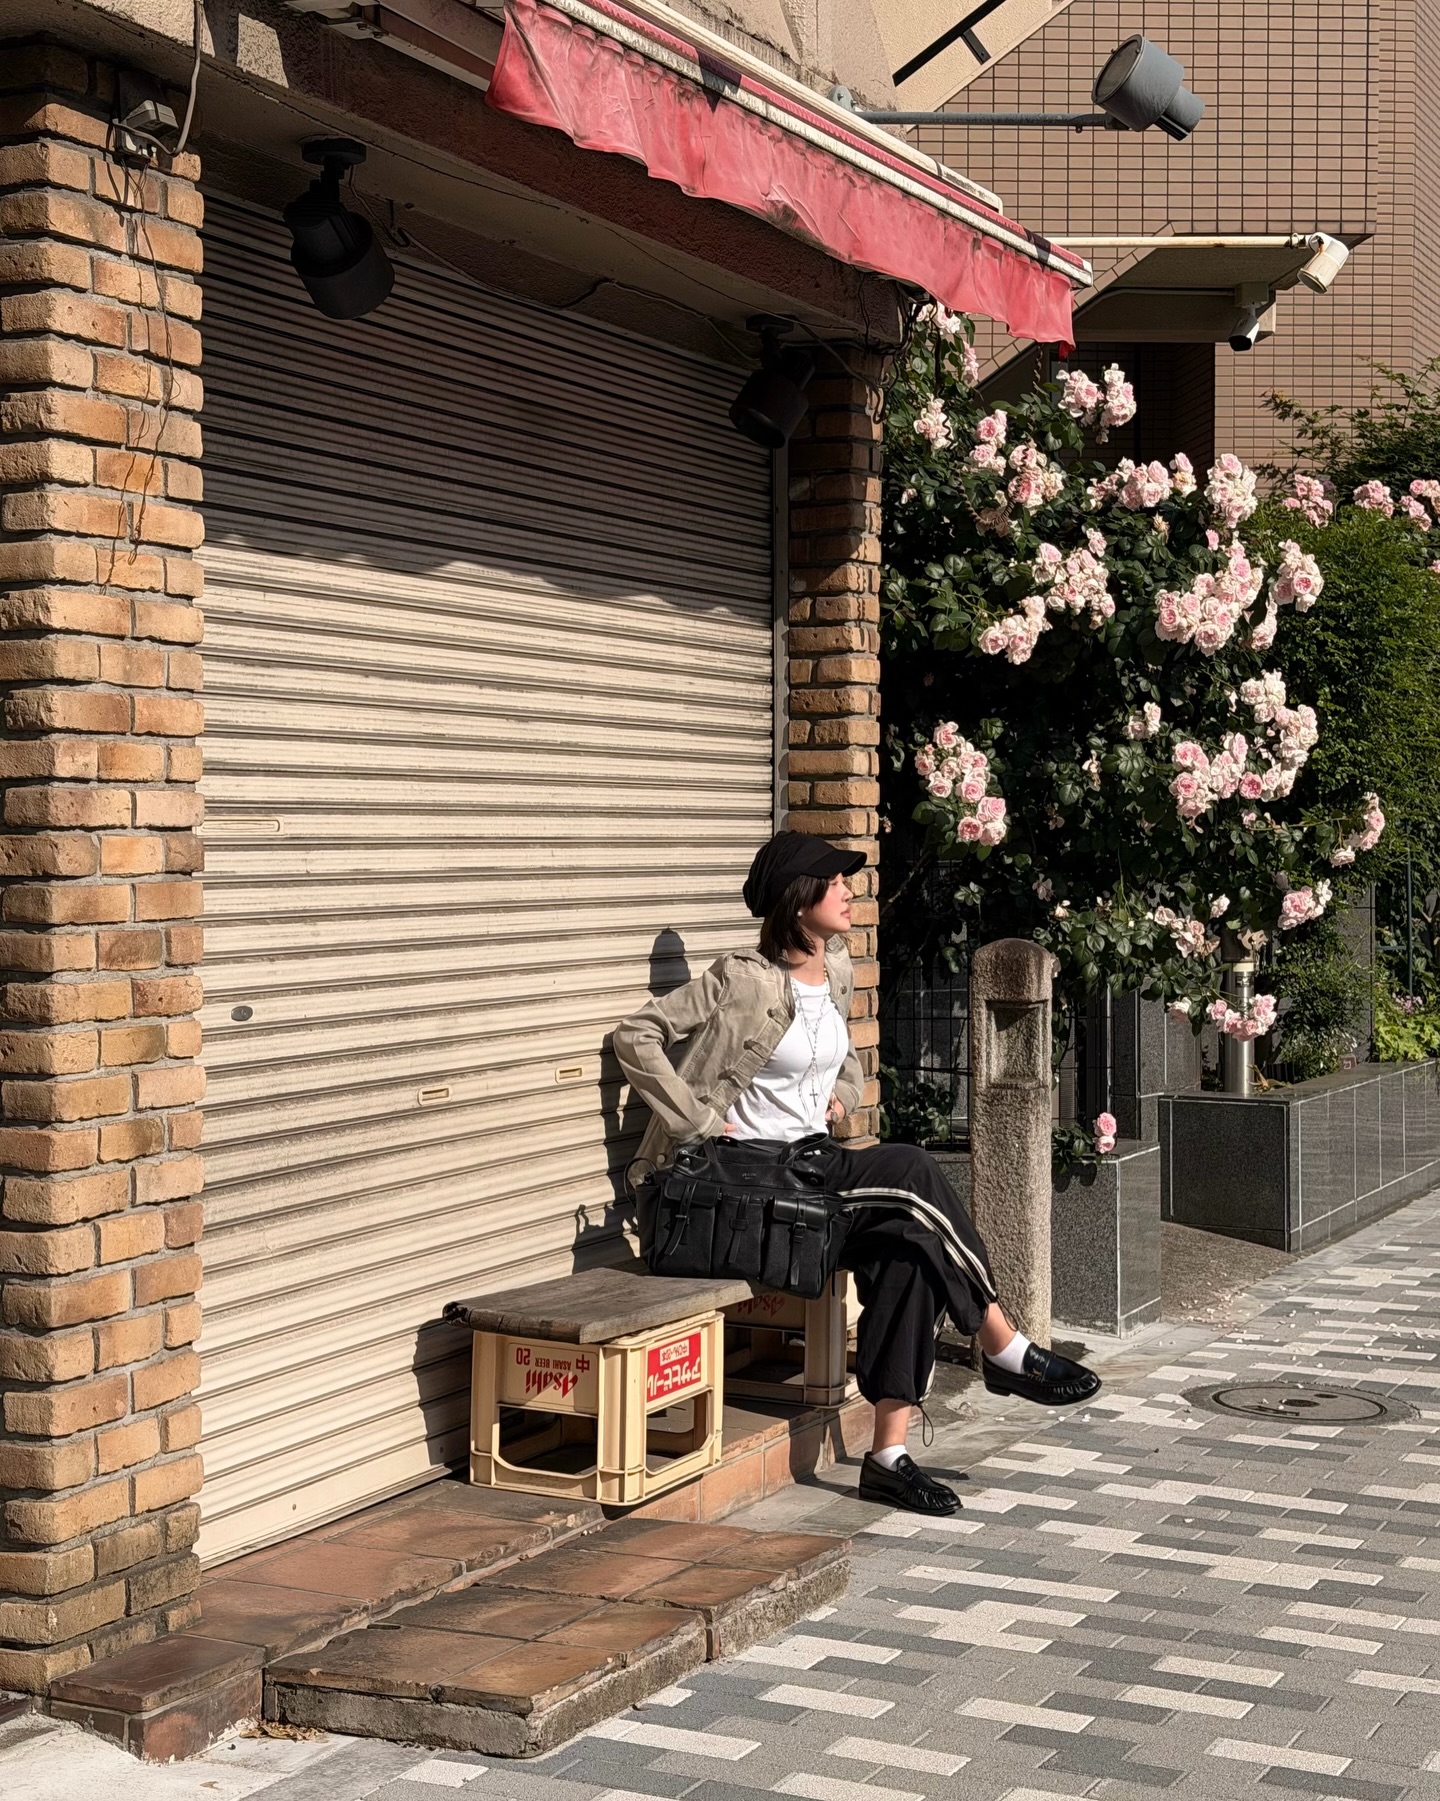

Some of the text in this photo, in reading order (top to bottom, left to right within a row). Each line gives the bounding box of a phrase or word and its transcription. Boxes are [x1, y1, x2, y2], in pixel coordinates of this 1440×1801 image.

[737, 1294, 786, 1317] Asahi
[516, 1347, 590, 1373] 中 ASAHI BEER 20
[525, 1368, 579, 1399] Asahi
[647, 1356, 701, 1397] アサヒビール
